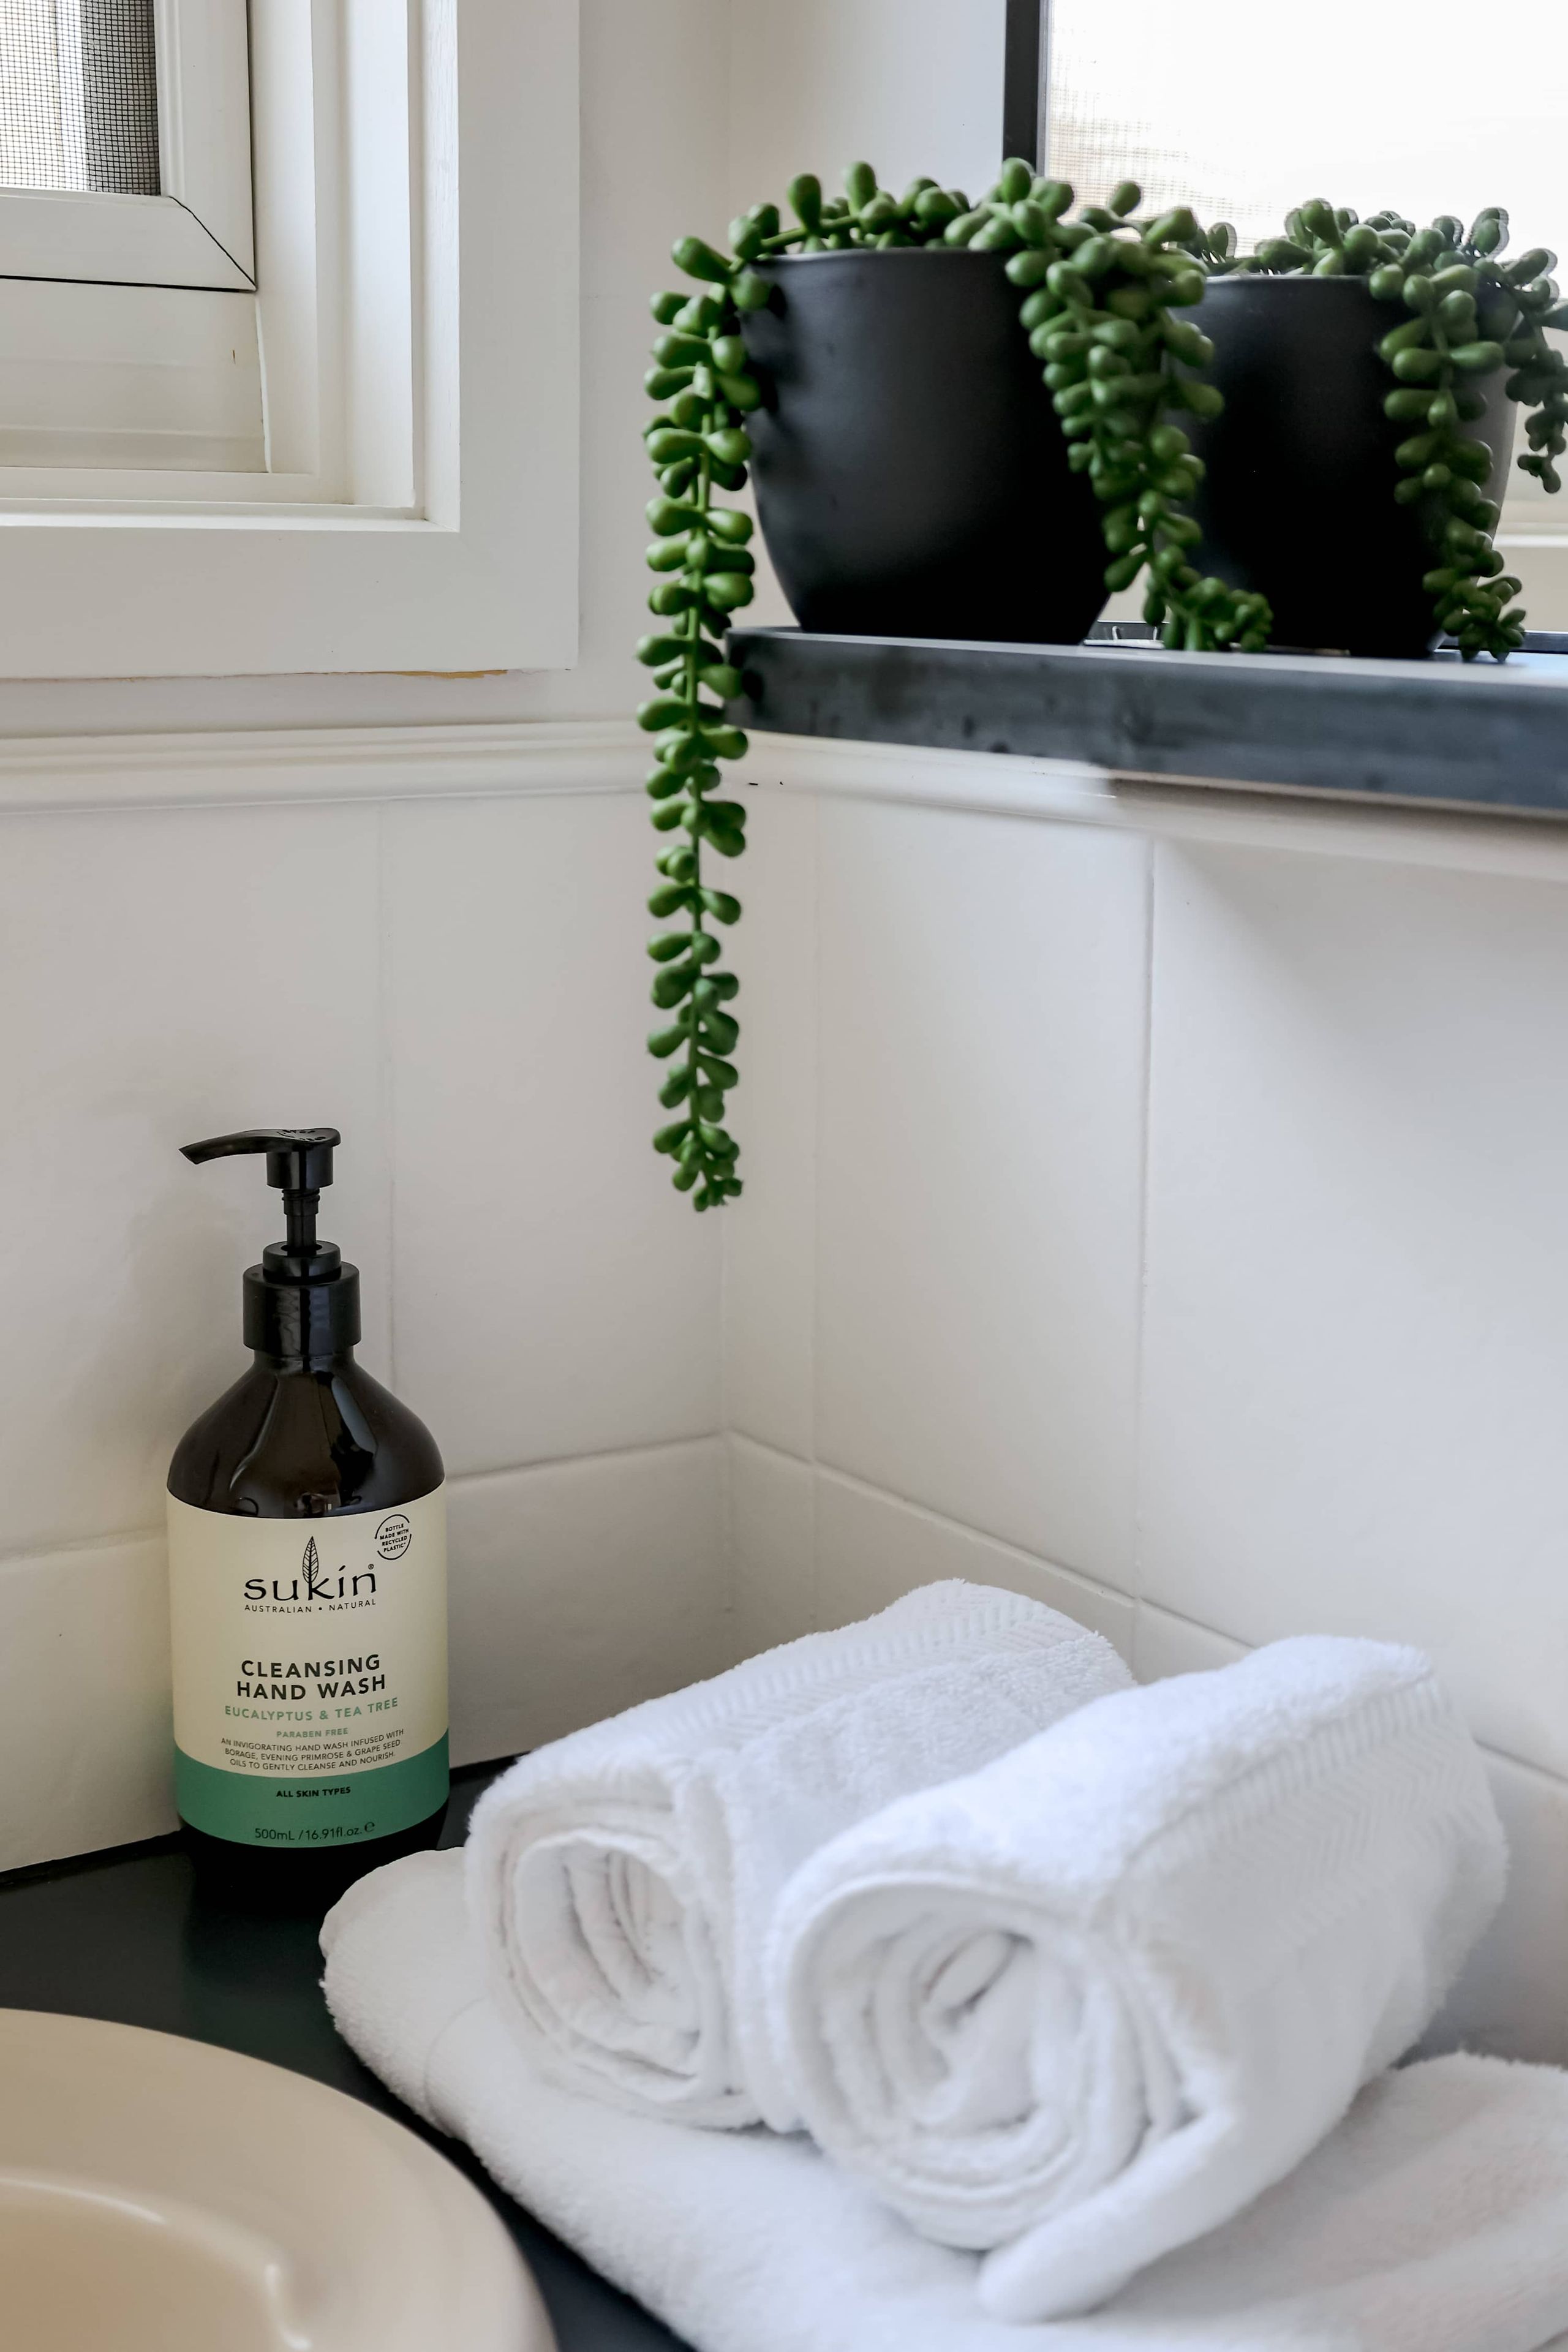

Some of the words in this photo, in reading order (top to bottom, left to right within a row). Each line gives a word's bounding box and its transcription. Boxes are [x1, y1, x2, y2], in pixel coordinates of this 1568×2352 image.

[385, 1523, 404, 1532] BOTTLE
[382, 1536, 407, 1546] RECYCLED
[244, 1604, 312, 1613] AUSTRALIAN
[329, 1599, 376, 1611] NATURAL
[241, 1654, 380, 1678] CLEANSING
[236, 1681, 306, 1700] HAND
[317, 1674, 385, 1698] WASH
[225, 1705, 312, 1721] EUCALYPTUS
[319, 1710, 329, 1720] &
[334, 1706, 362, 1718] TEA
[368, 1697, 398, 1713] TREE
[325, 1727, 349, 1736] FREE
[233, 1740, 292, 1752] INVIGORATING
[351, 1735, 384, 1746] INFUSED
[386, 1728, 404, 1740] WITH
[225, 1748, 258, 1760] BORAGE,
[301, 1752, 344, 1761] PRIMROSE
[355, 1744, 380, 1756] GRAPE
[383, 1740, 401, 1750] SEED
[230, 1758, 246, 1767] OILS
[298, 1762, 336, 1771] CLEANSE
[339, 1759, 357, 1768] AND
[322, 1786, 351, 1796] TYPES
[255, 1828, 295, 1841] 500mL
